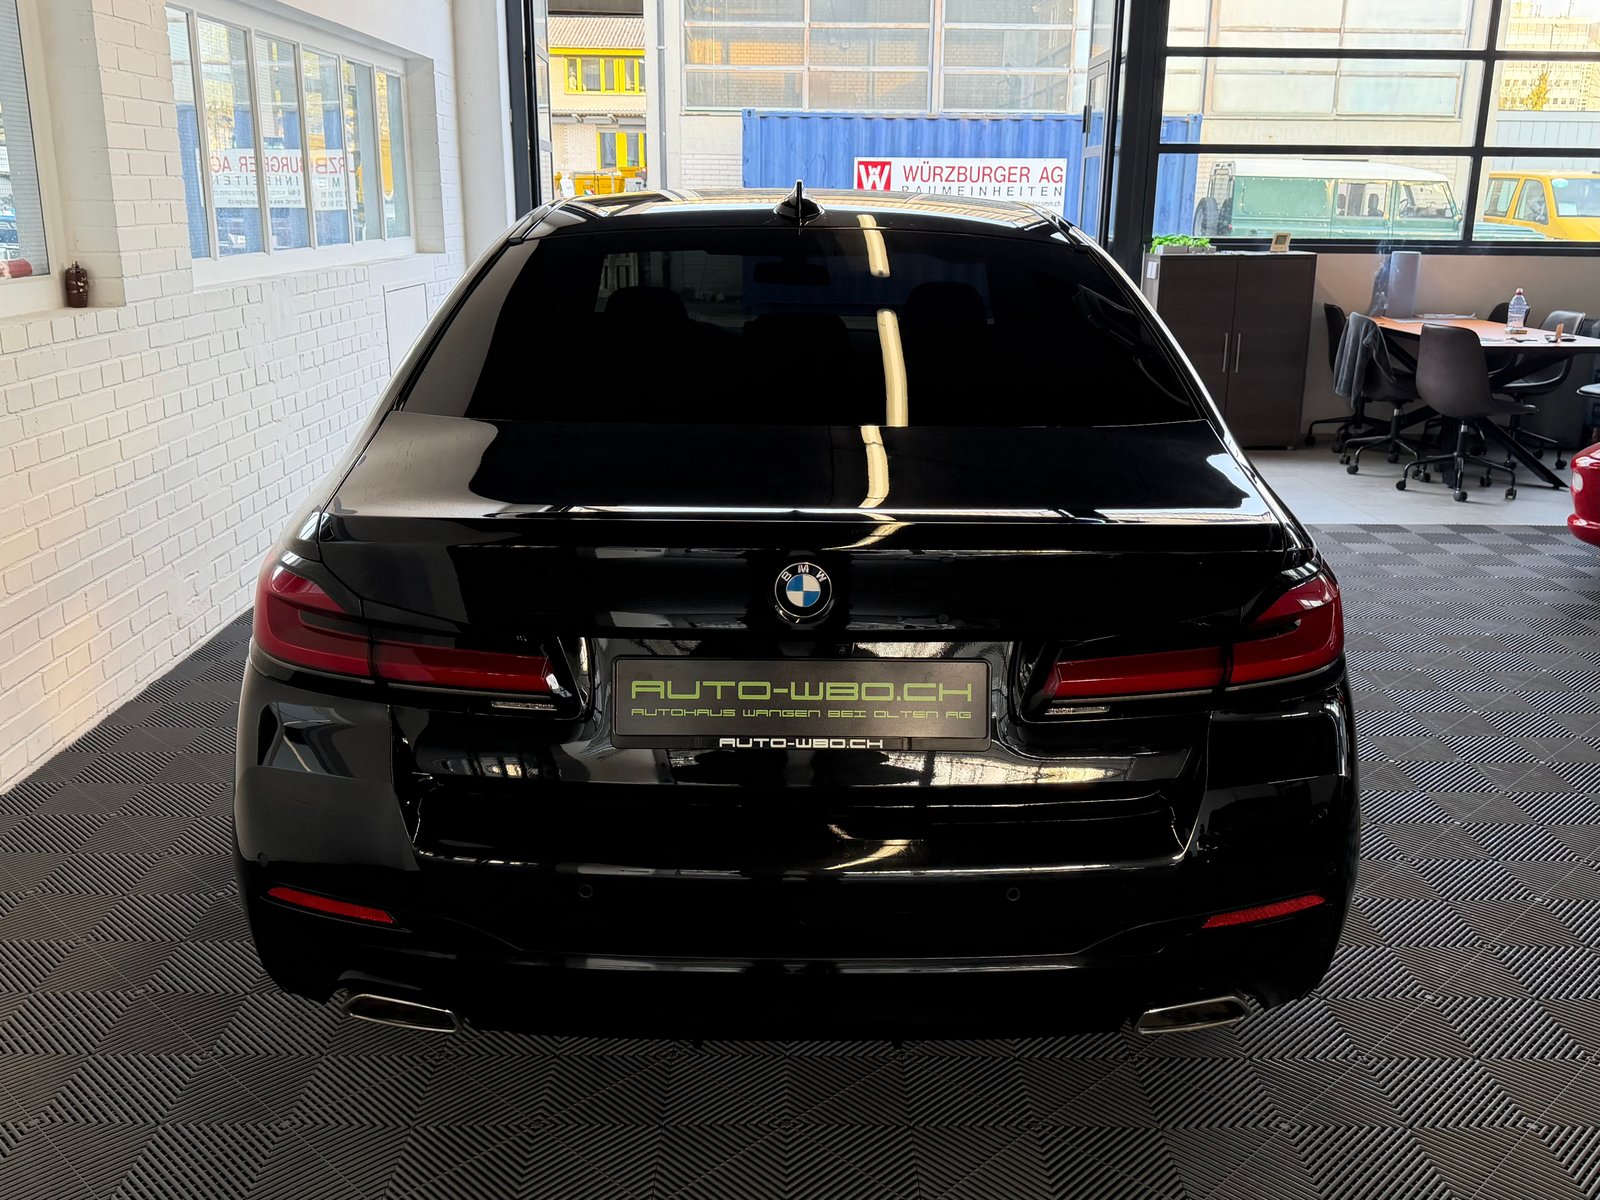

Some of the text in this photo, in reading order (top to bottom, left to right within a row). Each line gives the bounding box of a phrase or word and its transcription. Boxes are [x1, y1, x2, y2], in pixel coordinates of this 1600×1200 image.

[903, 161, 1063, 183] WÜRZBURGER AG
[780, 564, 828, 583] BMW
[631, 680, 973, 702] AUTO-WBO.CH
[631, 708, 973, 719] AUTOHAUS WANGEN BEI OLTEN AG
[719, 738, 884, 749] AUTO-WBO.CH
